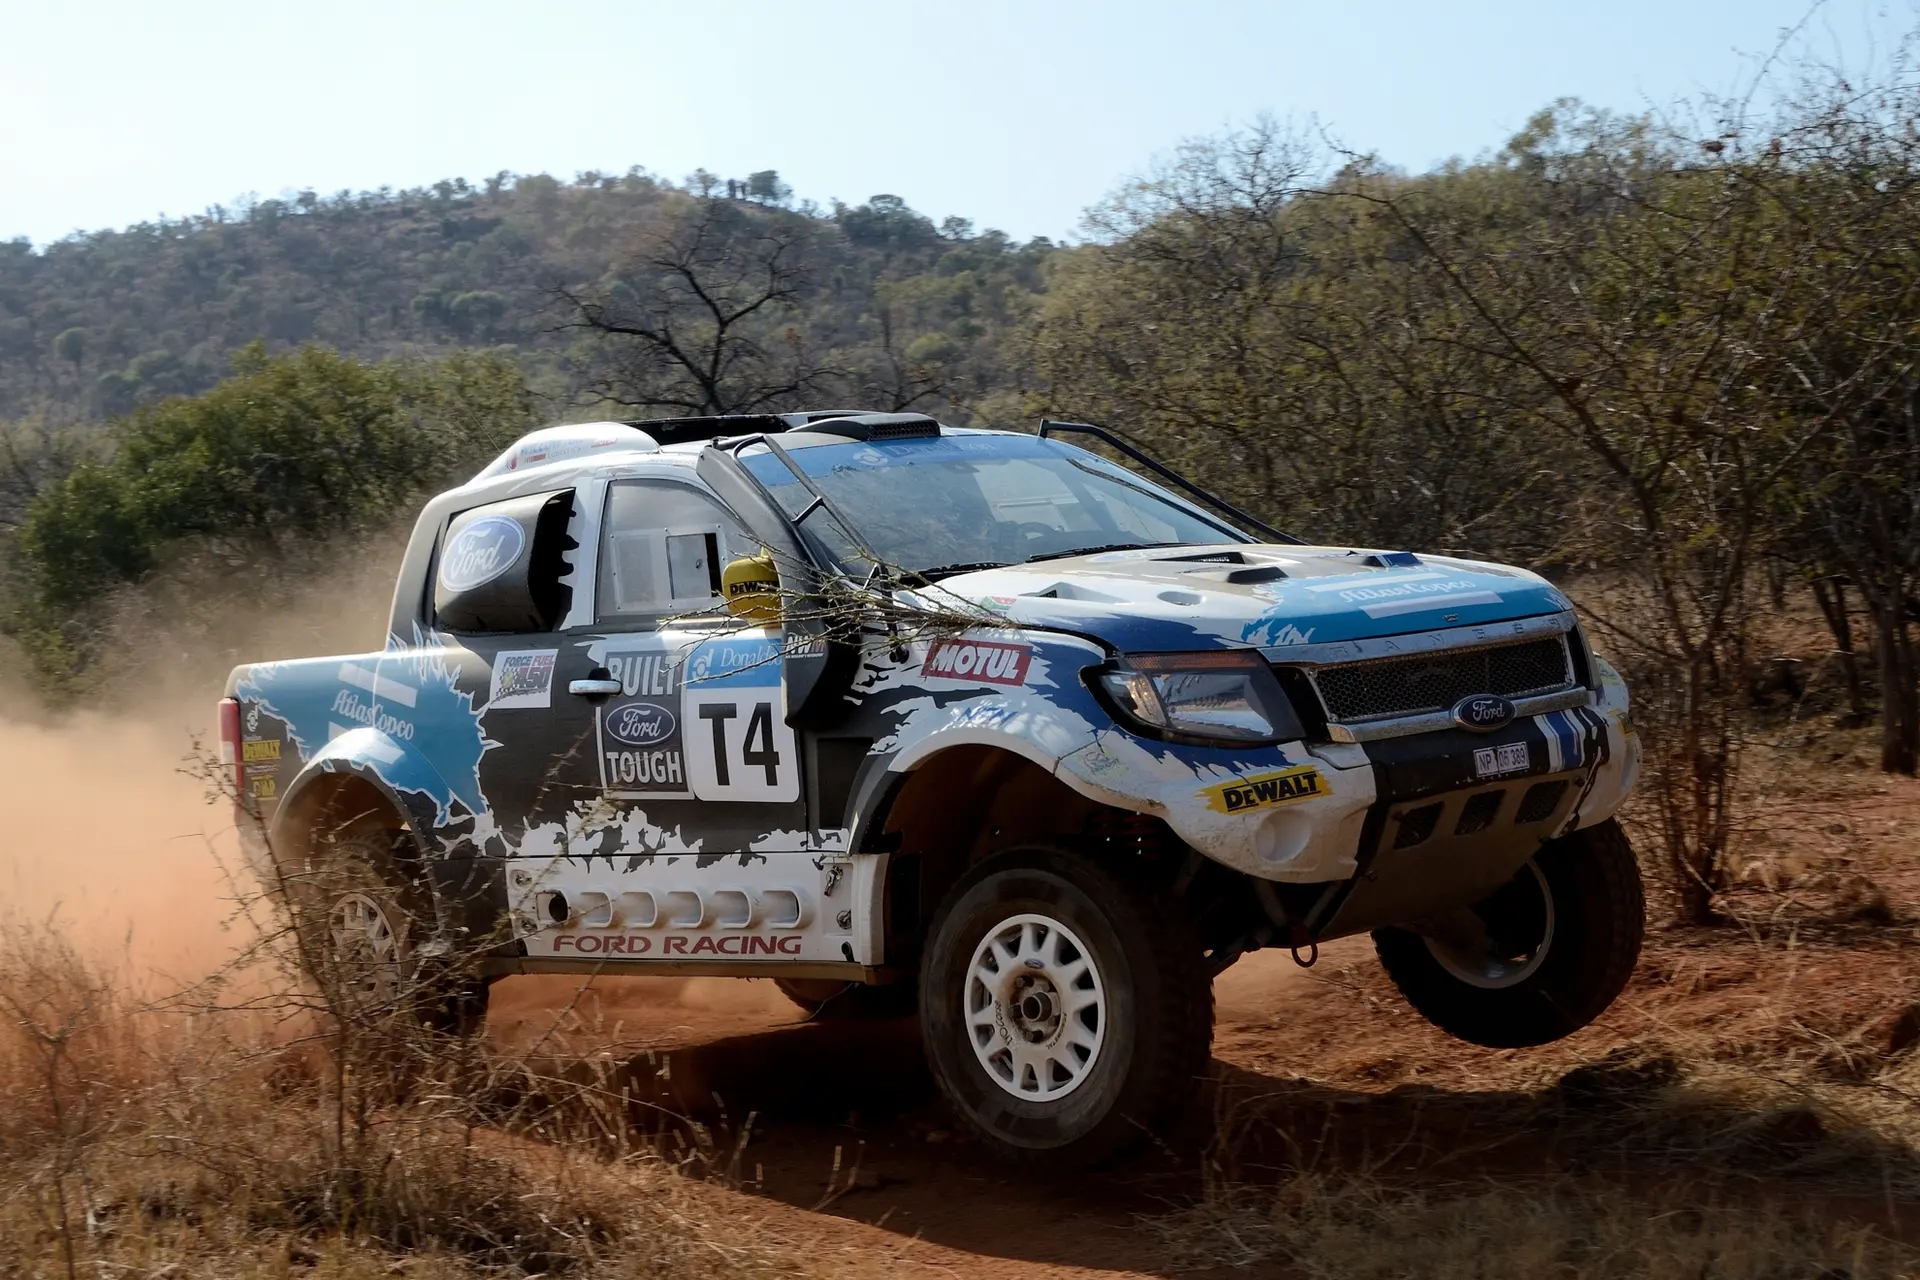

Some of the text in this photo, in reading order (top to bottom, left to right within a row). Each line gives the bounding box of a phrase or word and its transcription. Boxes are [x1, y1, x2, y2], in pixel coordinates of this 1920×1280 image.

[450, 527, 506, 580] Ford
[503, 655, 533, 668] FORCE
[720, 645, 783, 667] Donaldso
[930, 644, 1020, 679] MOTUL
[607, 654, 683, 697] BUILT
[619, 708, 662, 737] Ford
[1472, 700, 1506, 722] Ford
[699, 702, 781, 787] T4
[606, 751, 683, 784] TOUGH
[1478, 753, 1492, 771] NP
[553, 935, 803, 955] FORD RACING
